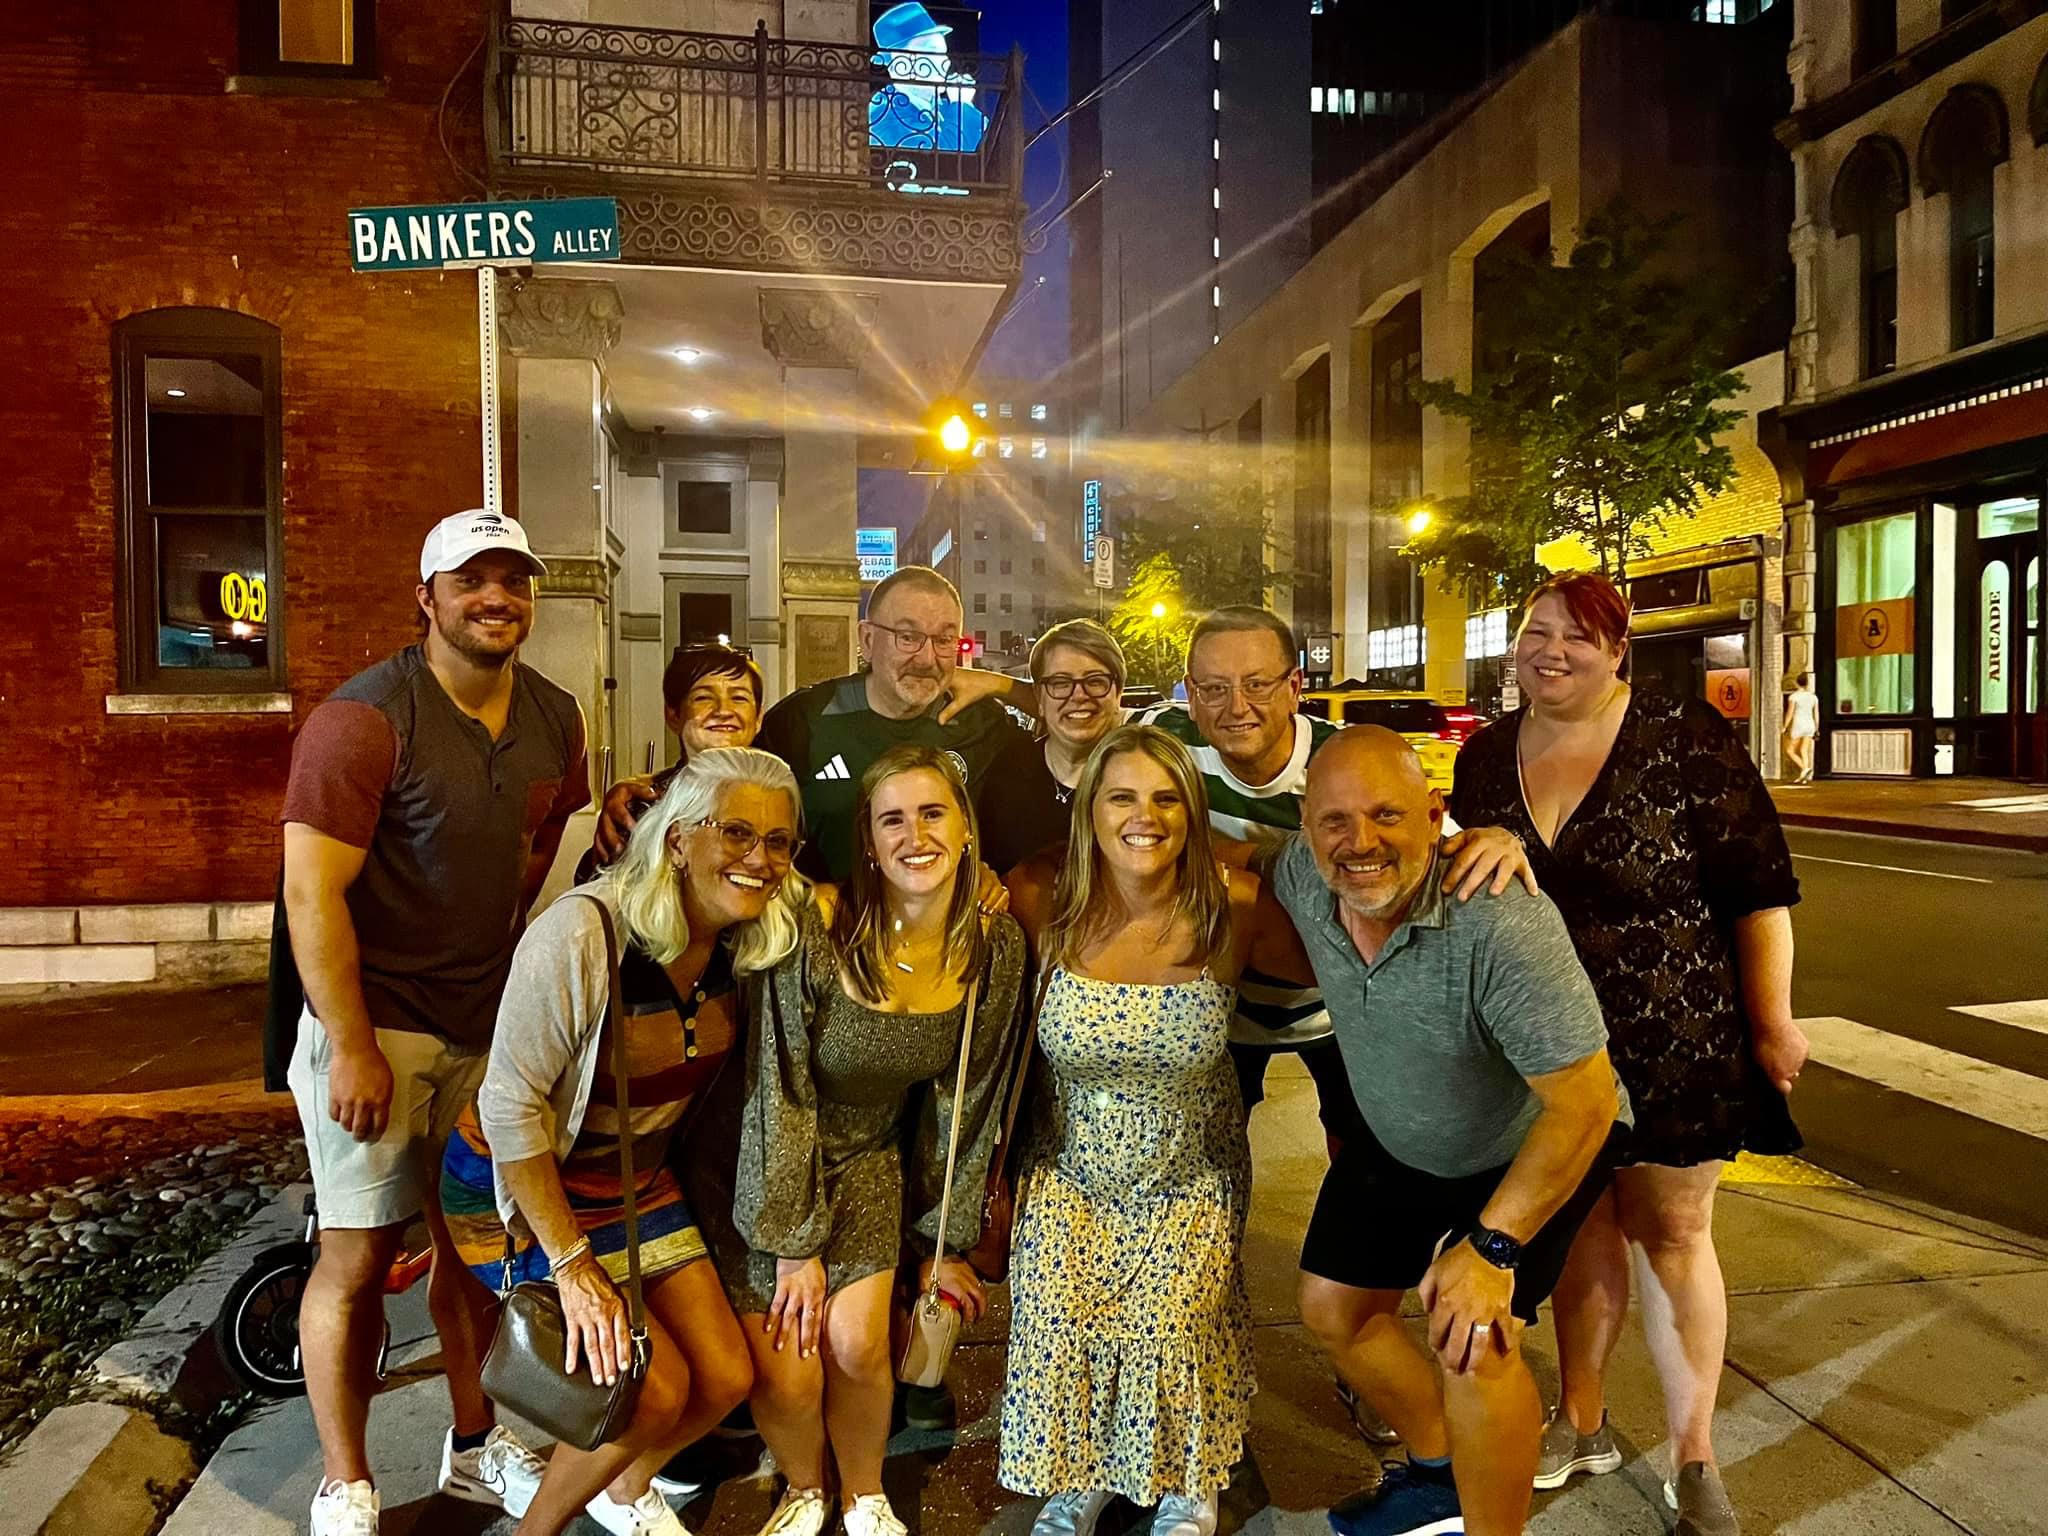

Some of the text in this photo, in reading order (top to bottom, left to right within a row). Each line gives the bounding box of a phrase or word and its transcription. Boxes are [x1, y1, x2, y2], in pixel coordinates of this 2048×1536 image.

[354, 210, 612, 262] BANKERS ALLEY
[485, 525, 510, 535] open
[1989, 591, 2000, 682] ARCADE
